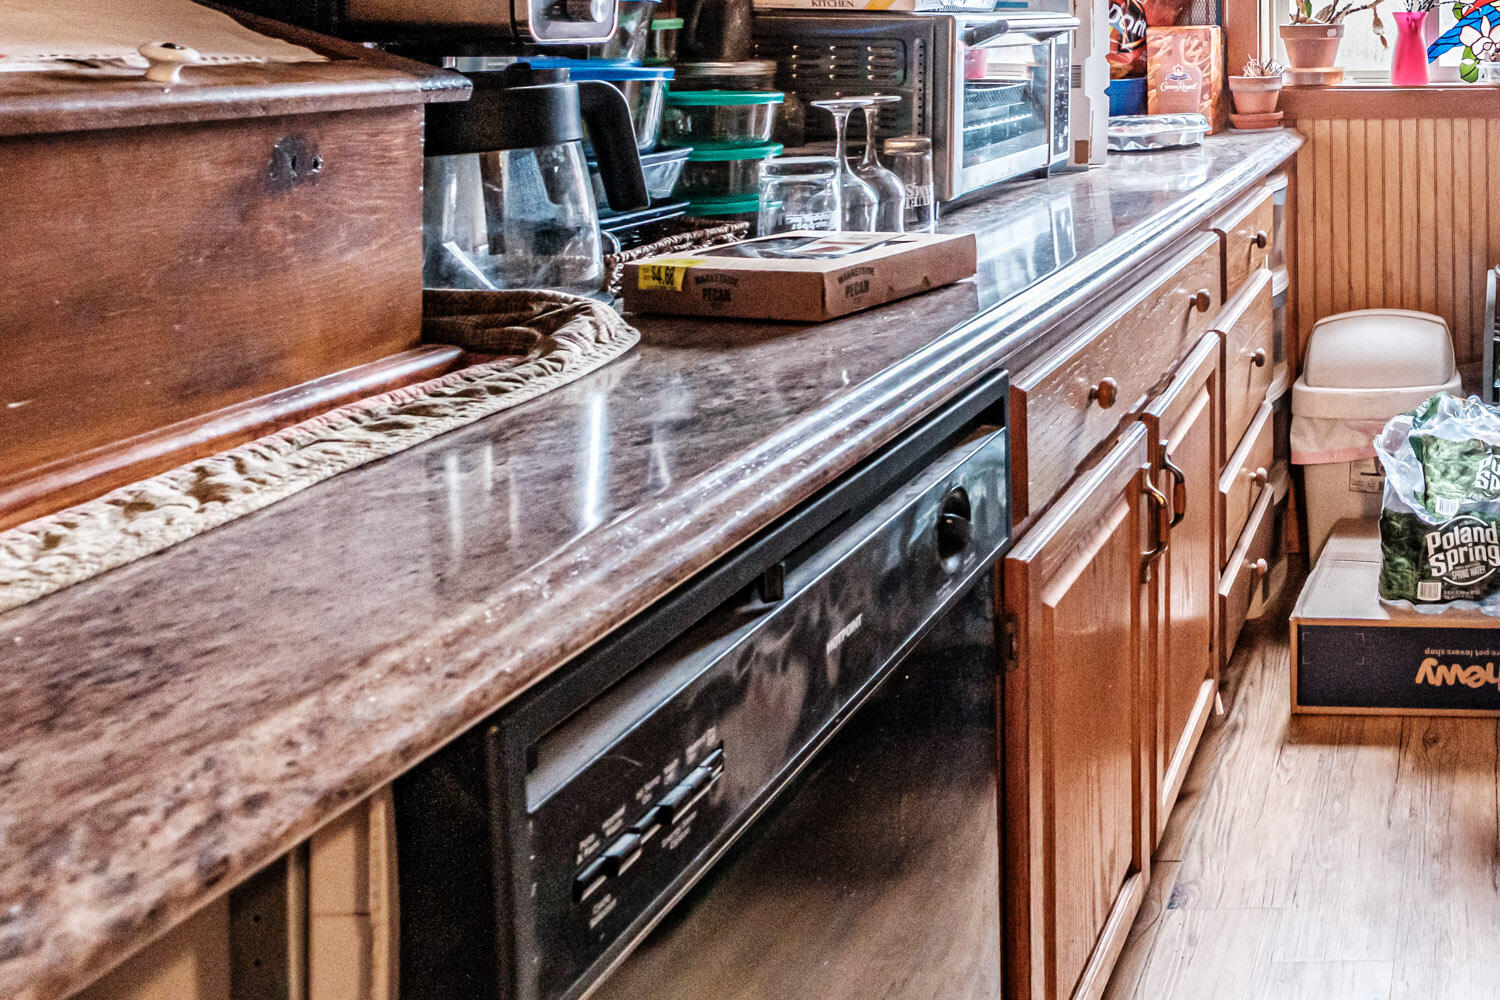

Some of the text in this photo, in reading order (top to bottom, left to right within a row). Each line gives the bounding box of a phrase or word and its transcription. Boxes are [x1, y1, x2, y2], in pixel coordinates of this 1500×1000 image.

[810, 0, 855, 9] KITCHEN
[702, 287, 732, 302] PECAN
[844, 281, 870, 299] PECAN
[1426, 519, 1499, 556] Poland
[1424, 647, 1444, 657] shop
[1445, 648, 1474, 658] lovers
[1475, 649, 1489, 660] pet
